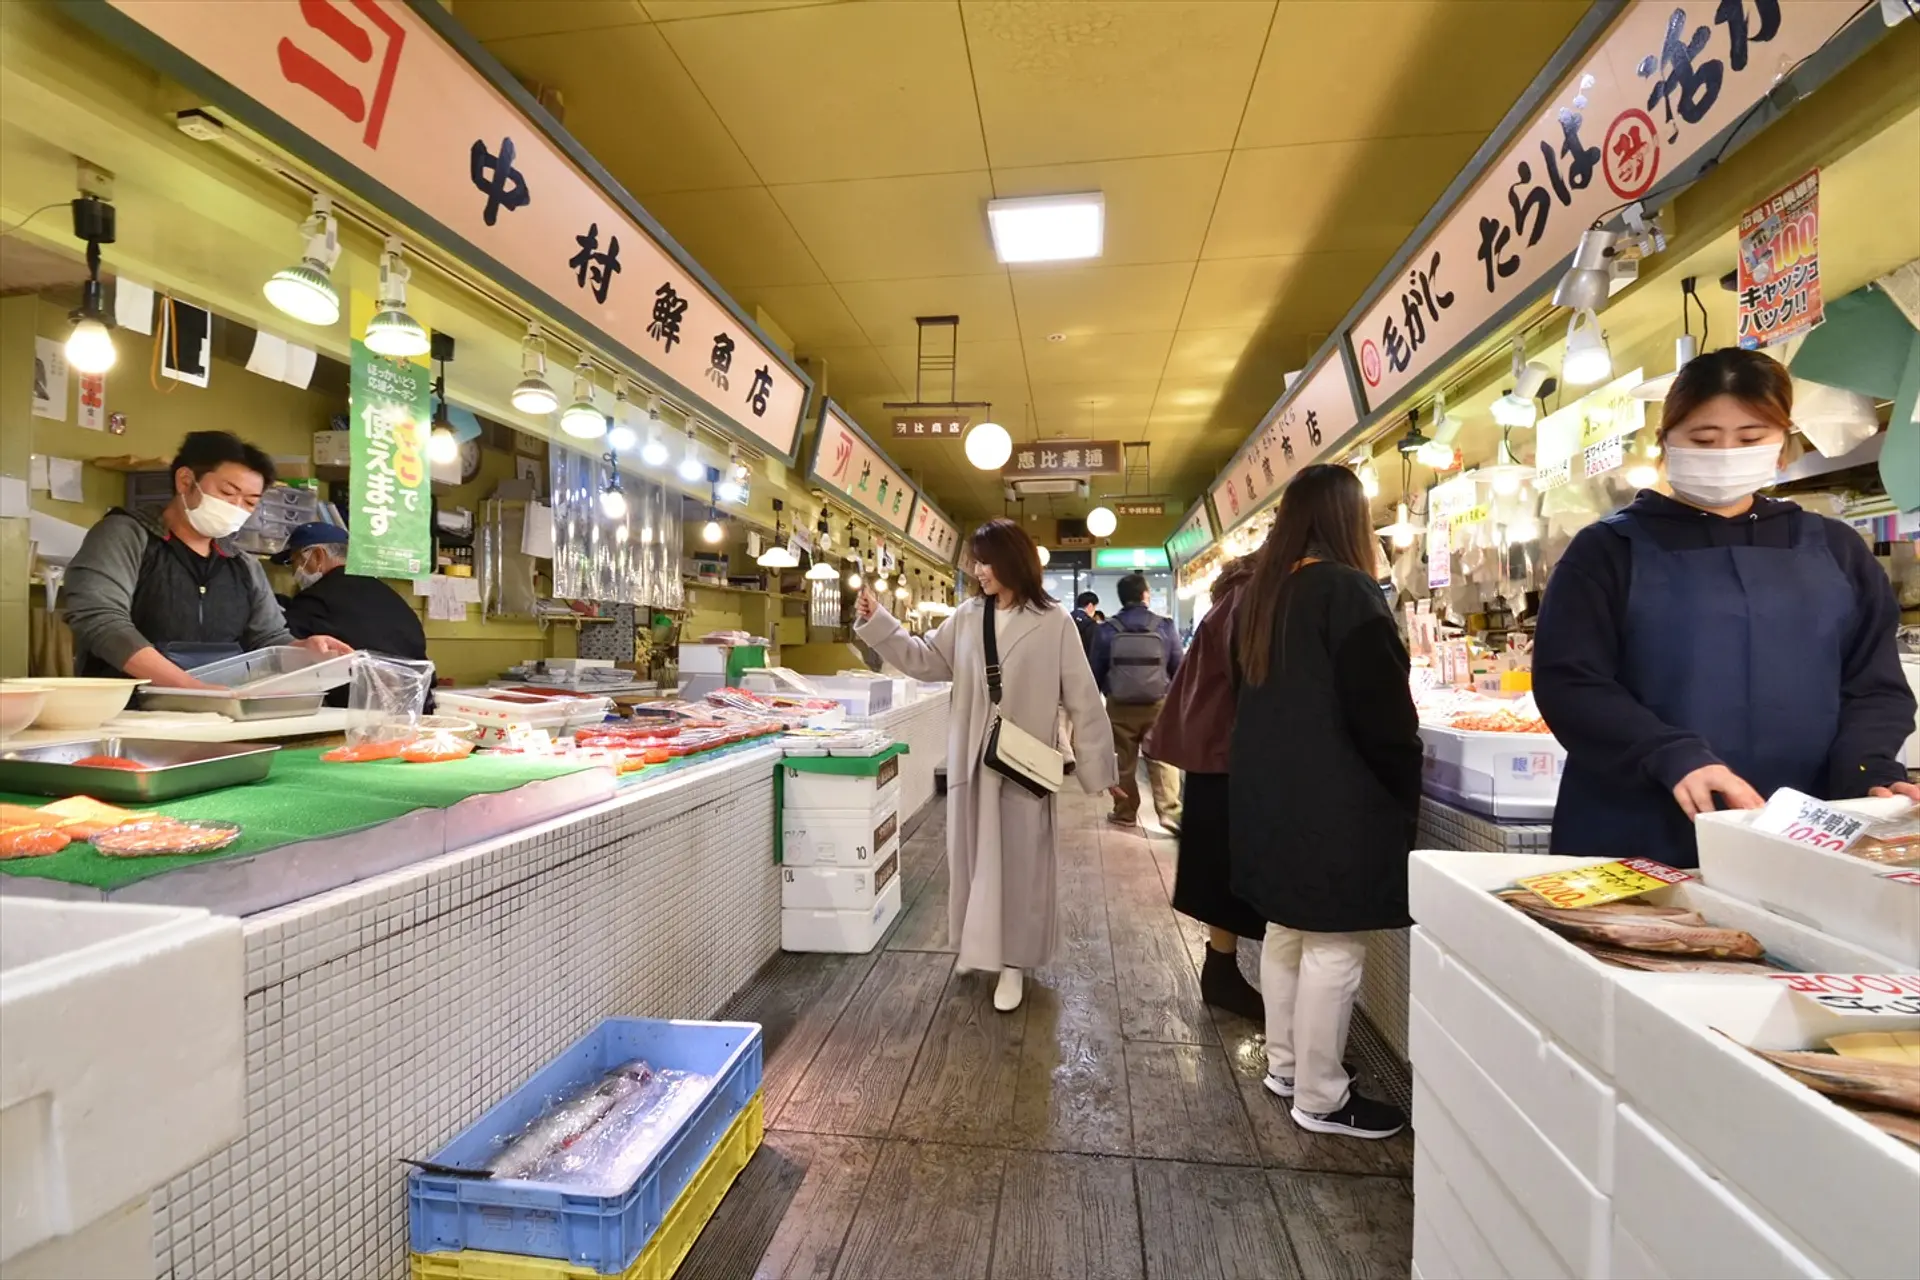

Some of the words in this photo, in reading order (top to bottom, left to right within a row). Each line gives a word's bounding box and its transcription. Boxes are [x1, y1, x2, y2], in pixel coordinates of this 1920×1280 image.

[1381, 252, 1455, 373] 毛がに
[1476, 74, 1601, 294] たらば
[470, 136, 773, 417] 中村鮮魚店
[1739, 261, 1819, 309] キャッシュ
[366, 362, 418, 390] ほっかいどう
[360, 403, 397, 536] 使えます
[855, 846, 867, 860] 10
